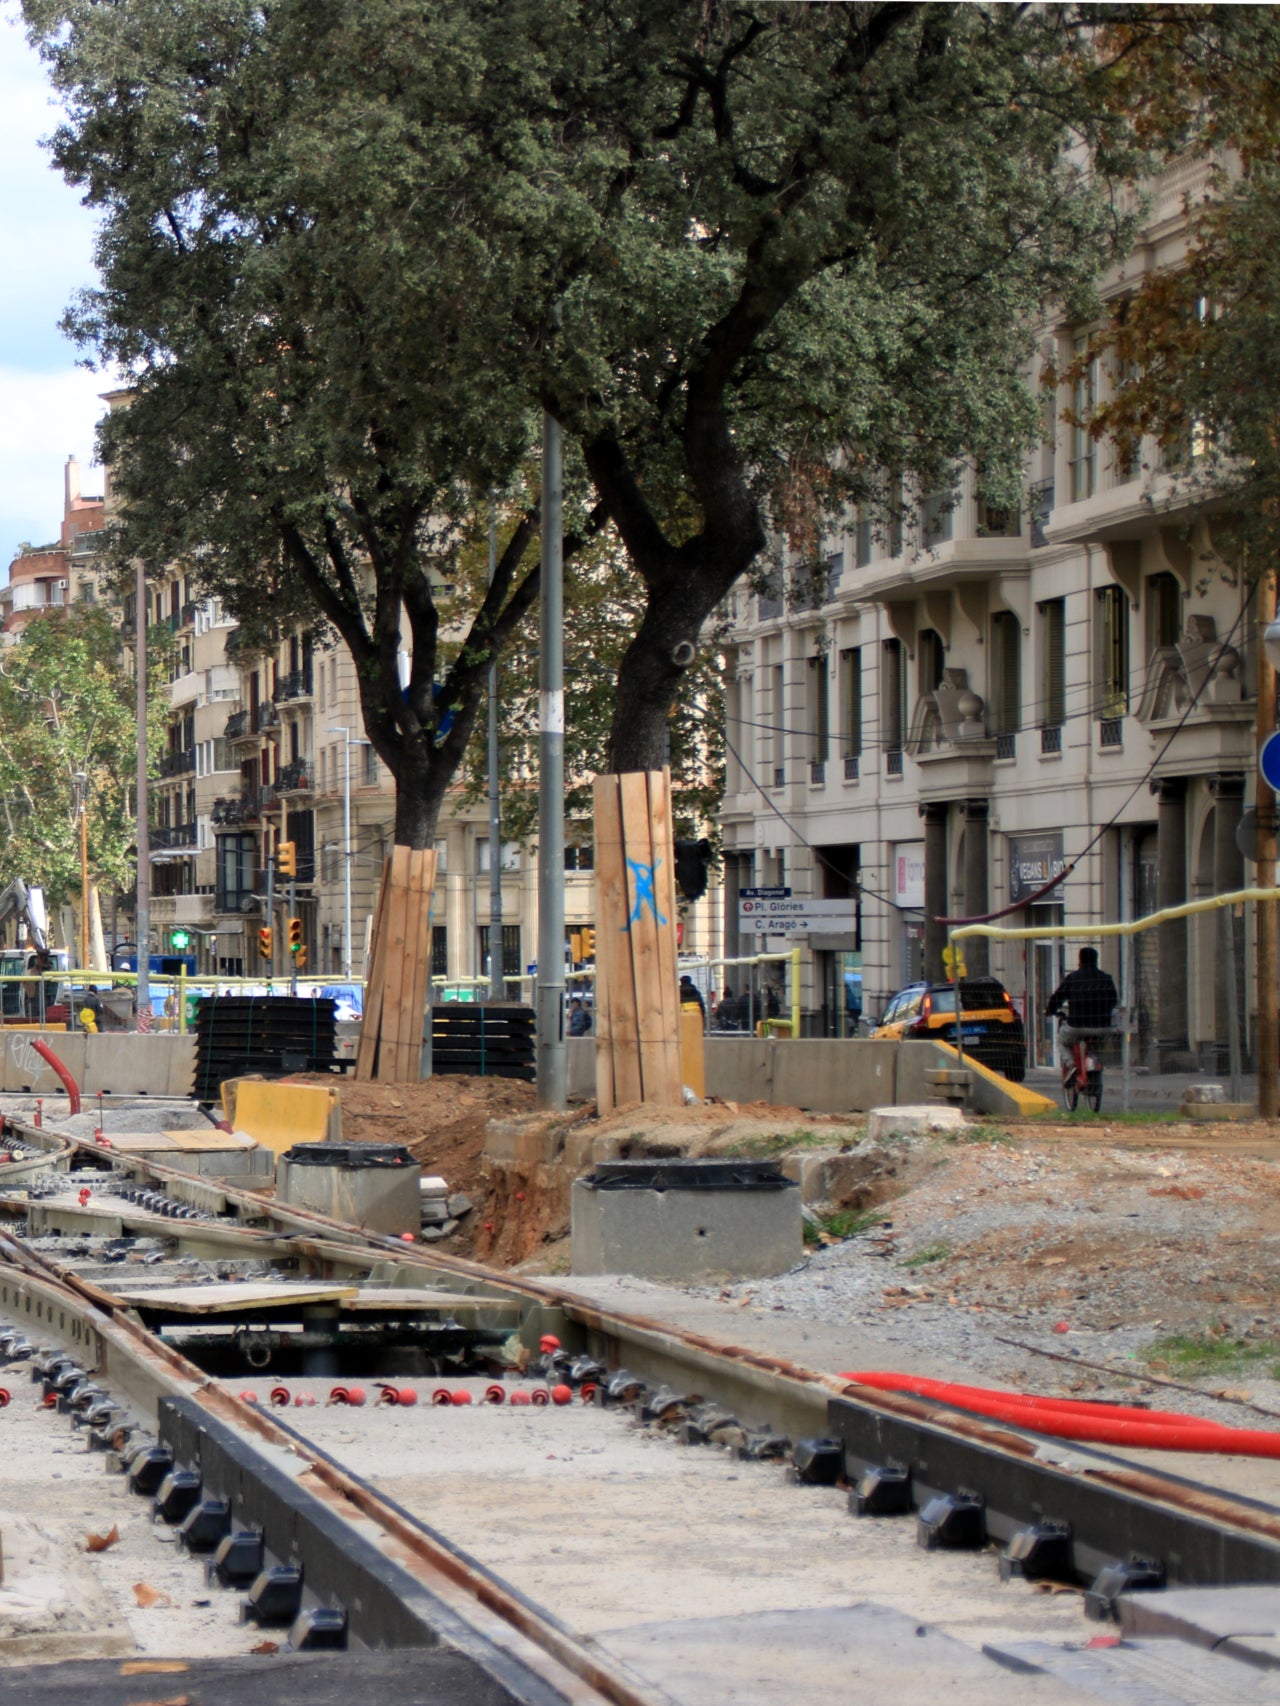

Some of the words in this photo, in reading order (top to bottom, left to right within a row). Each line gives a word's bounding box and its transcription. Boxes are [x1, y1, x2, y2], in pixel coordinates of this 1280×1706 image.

[1019, 862, 1042, 880] VEGANS
[755, 903, 767, 911] Pl.
[770, 902, 804, 911] Glòries
[755, 920, 765, 929] C.
[768, 920, 797, 931] Aragó
